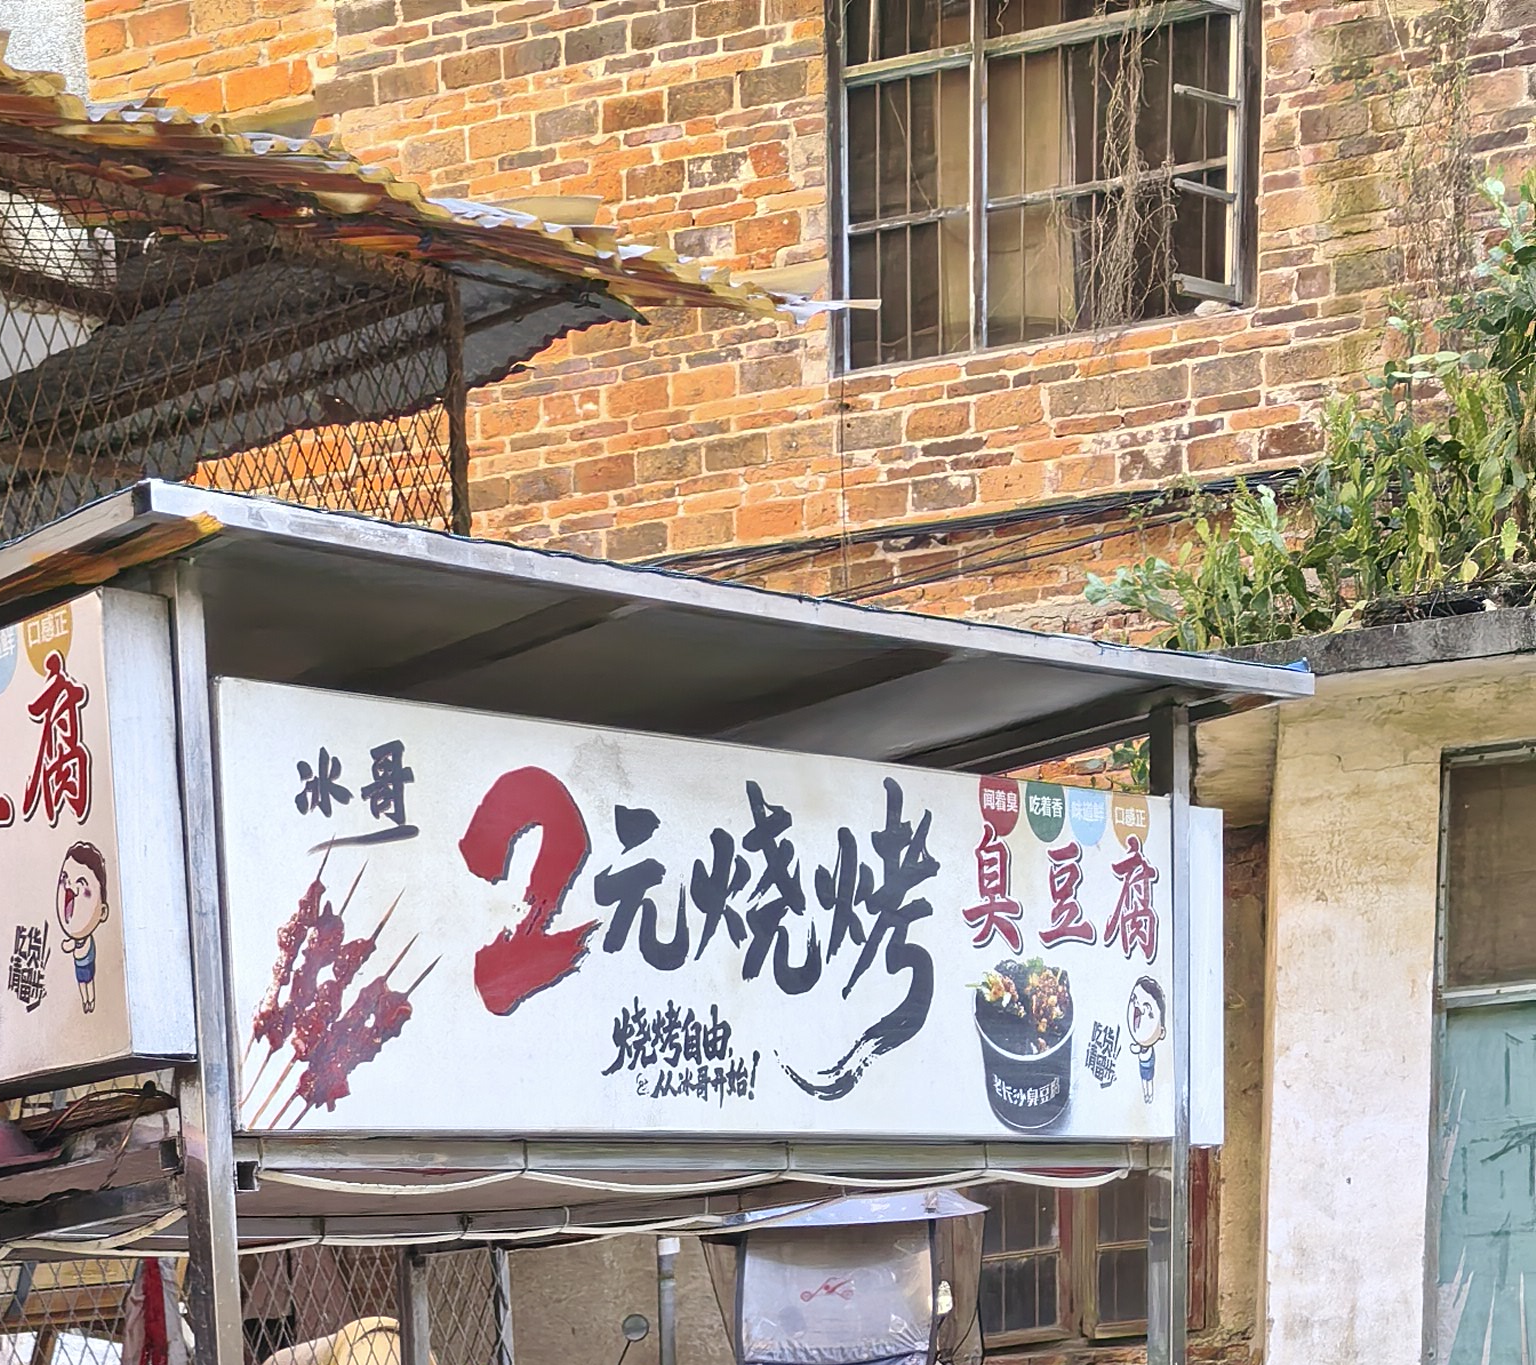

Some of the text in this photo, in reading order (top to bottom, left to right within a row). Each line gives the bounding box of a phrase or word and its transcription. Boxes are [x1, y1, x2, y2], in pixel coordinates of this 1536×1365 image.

[28, 610, 69, 647] 口感正
[295, 739, 419, 852] 冰哥
[982, 788, 1019, 813] 闻着臭
[1028, 794, 1064, 819] 吃着香
[1114, 806, 1147, 828] 口感正
[963, 822, 1158, 964] 臭豆腐
